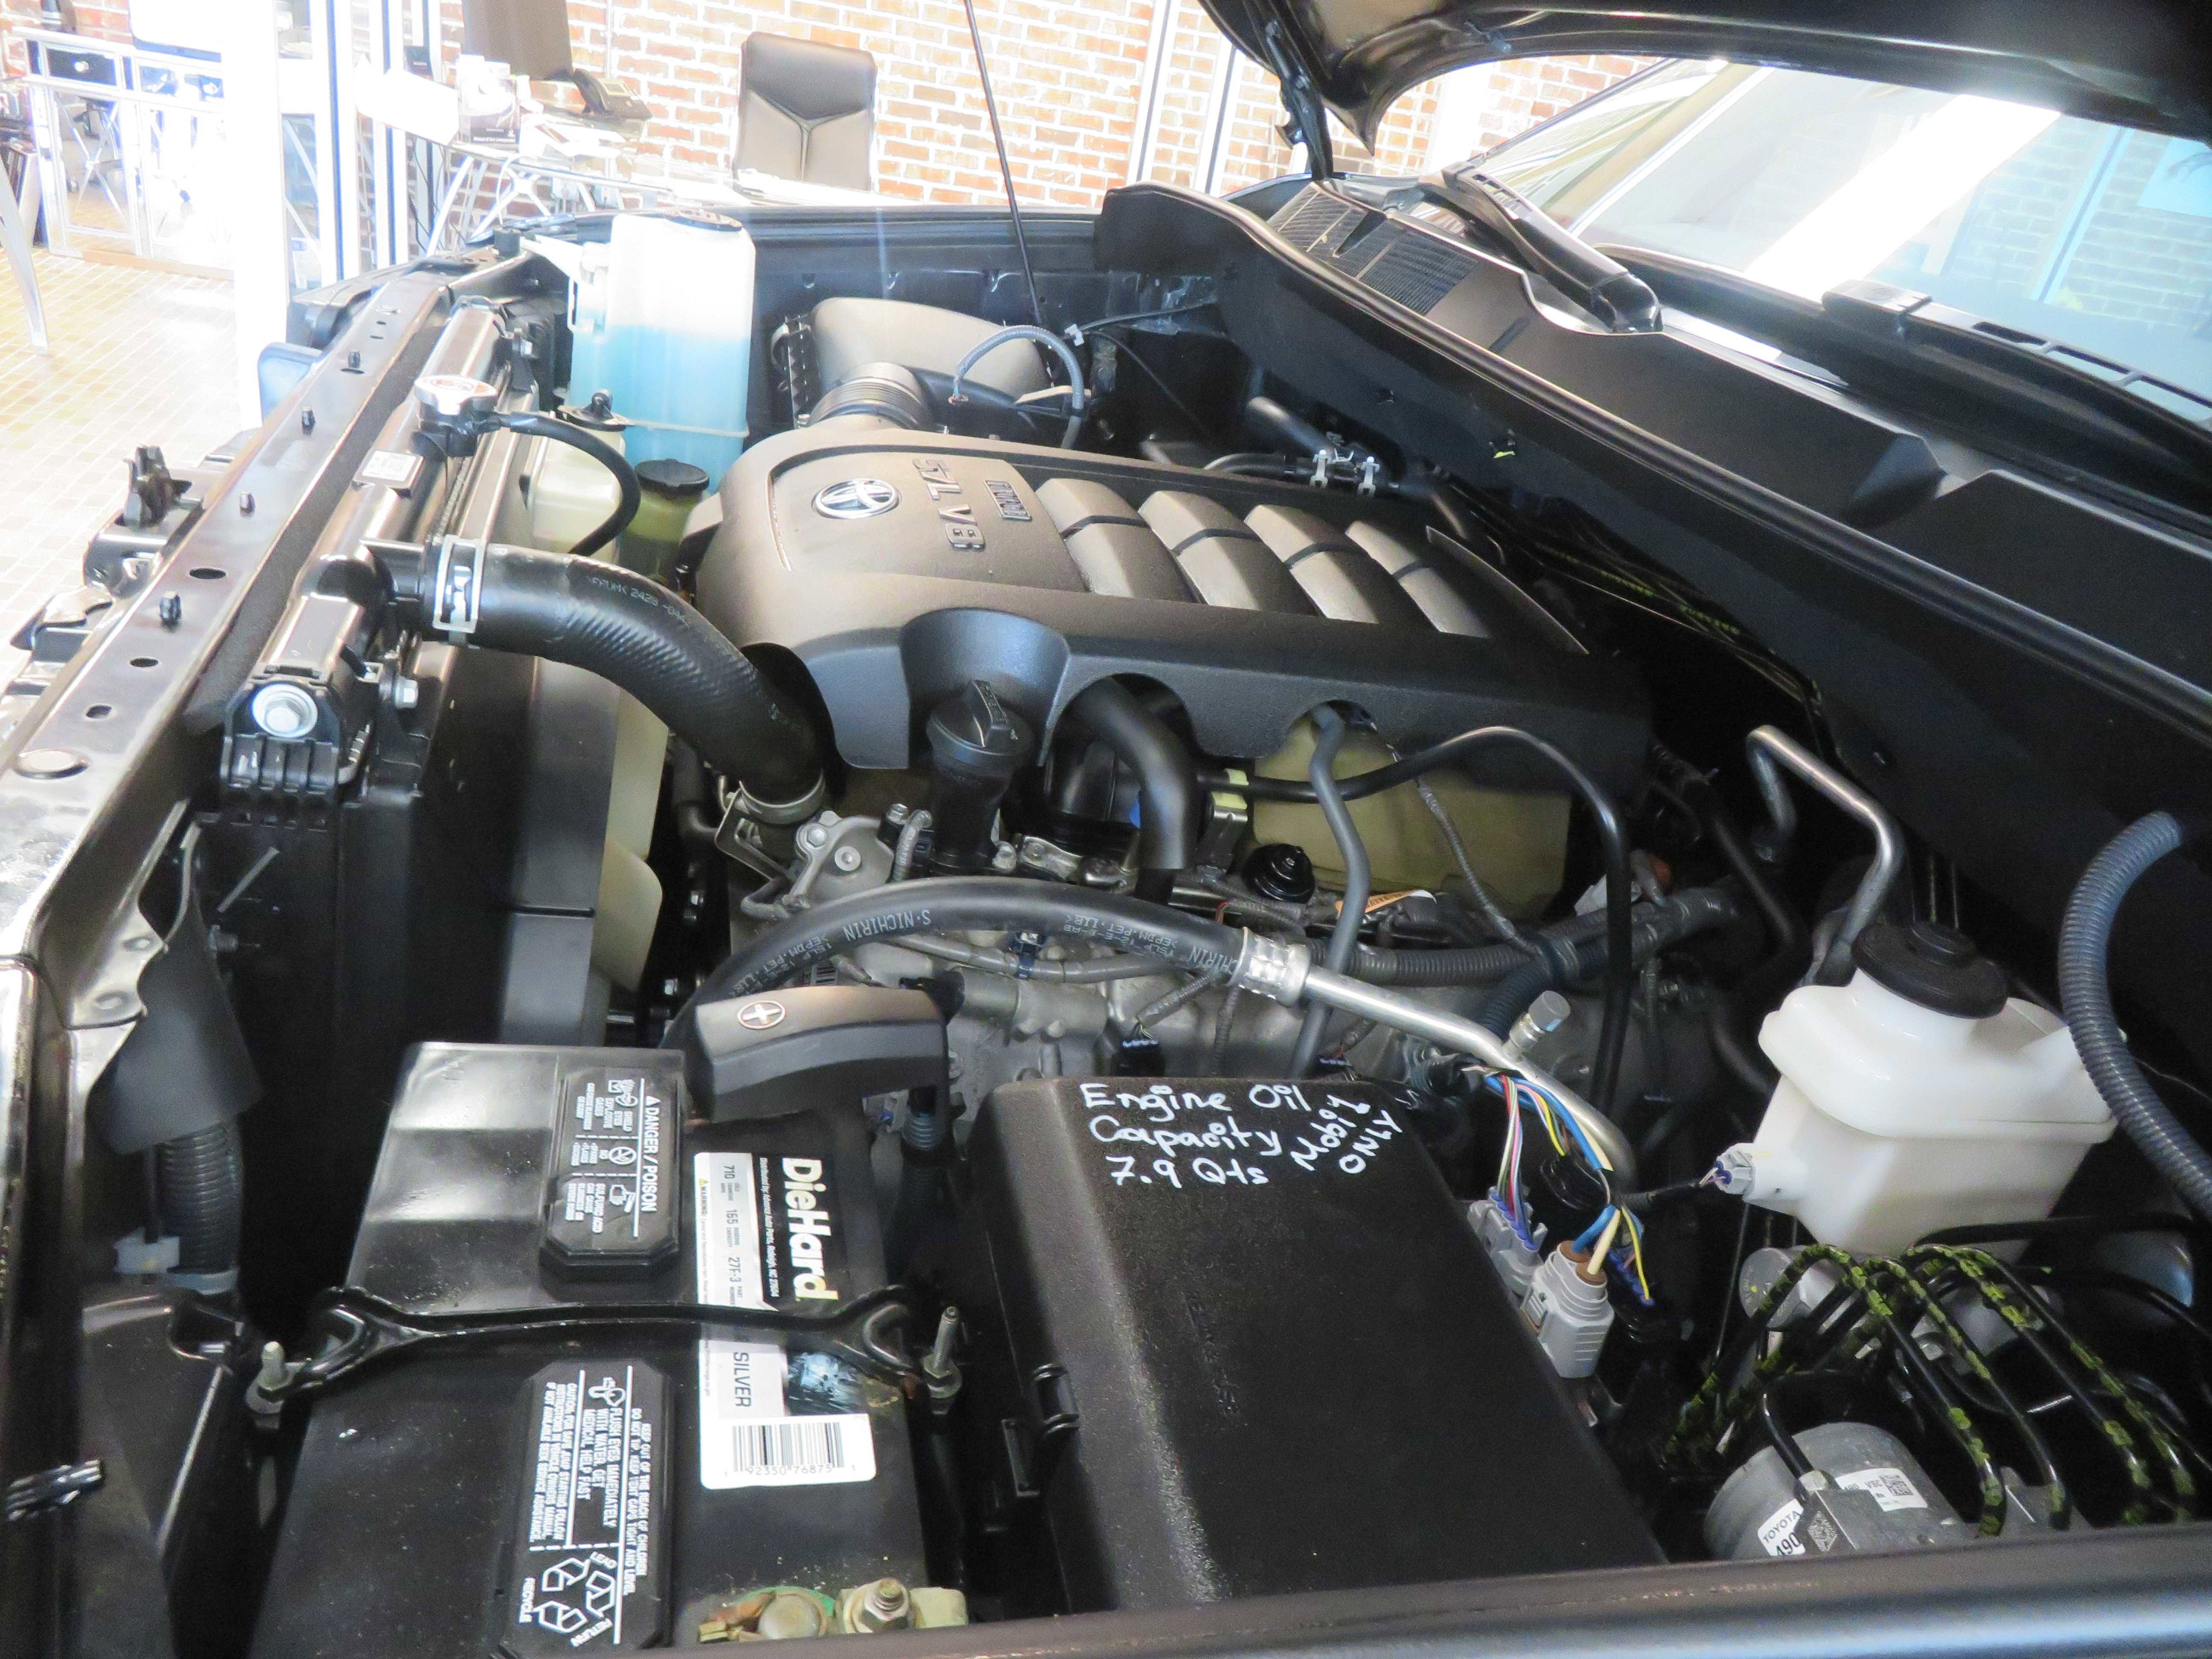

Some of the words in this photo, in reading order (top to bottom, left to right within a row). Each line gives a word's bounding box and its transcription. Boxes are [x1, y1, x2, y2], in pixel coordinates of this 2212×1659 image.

[939, 504, 985, 549] V8
[594, 1097, 604, 1117] GASES
[603, 1097, 614, 1128] EXPLOSIVE
[1079, 1083, 1232, 1122] Engine
[1249, 1084, 1312, 1111] Oil
[614, 1111, 623, 1126] EYES
[623, 1111, 633, 1132] SHIELD
[644, 1107, 660, 1153] DANGER
[1089, 1115, 1282, 1157] Capacity
[1339, 1110, 1403, 1174] ONLY
[599, 1150, 608, 1159] NO
[724, 1165, 735, 1179] 710
[1106, 1155, 1182, 1188] 7.9
[1193, 1157, 1269, 1184] Qts
[641, 1166, 658, 1212] POISON
[592, 1217, 603, 1233] ACID
[765, 1215, 774, 1228] Auto
[783, 1157, 838, 1301] DieHard
[732, 1351, 751, 1408] SILVER
[544, 1391, 555, 1405] NOT
[564, 1415, 575, 1429] FOR
[596, 1408, 608, 1431] WITH
[609, 1408, 623, 1436] FLUSH
[632, 1408, 642, 1419] DO
[581, 1409, 596, 1447] MEDICAL
[630, 1421, 641, 1436] NOT
[640, 1423, 652, 1442] KEEP
[607, 1438, 621, 1462] EYES
[640, 1444, 651, 1459] OUT
[579, 1450, 593, 1474] HELP
[629, 1455, 640, 1474] KEEP
[640, 1461, 651, 1473] OF
[747, 1466, 787, 1476] 92350
[794, 1464, 832, 1474] 76875
[556, 1471, 570, 1508] STARTING
[577, 1476, 591, 1500] FAST
[592, 1469, 605, 1488] GET
[639, 1474, 650, 1490] THE
[602, 1464, 620, 1528] IMMEDIATELY
[638, 1492, 649, 1518] REACH
[627, 1498, 638, 1519] CAPS
[553, 1508, 567, 1540] FOLLOW
[626, 1522, 637, 1545] TIGHT
[637, 1520, 649, 1532] OF
[1762, 1511, 1802, 1544] TOYOTA
[589, 1551, 618, 1569] LEAD
[625, 1548, 636, 1566] AND
[636, 1534, 648, 1575] CHILDREN
[519, 1578, 536, 1623] RECYCLE
[570, 1618, 613, 1647] RETURN
